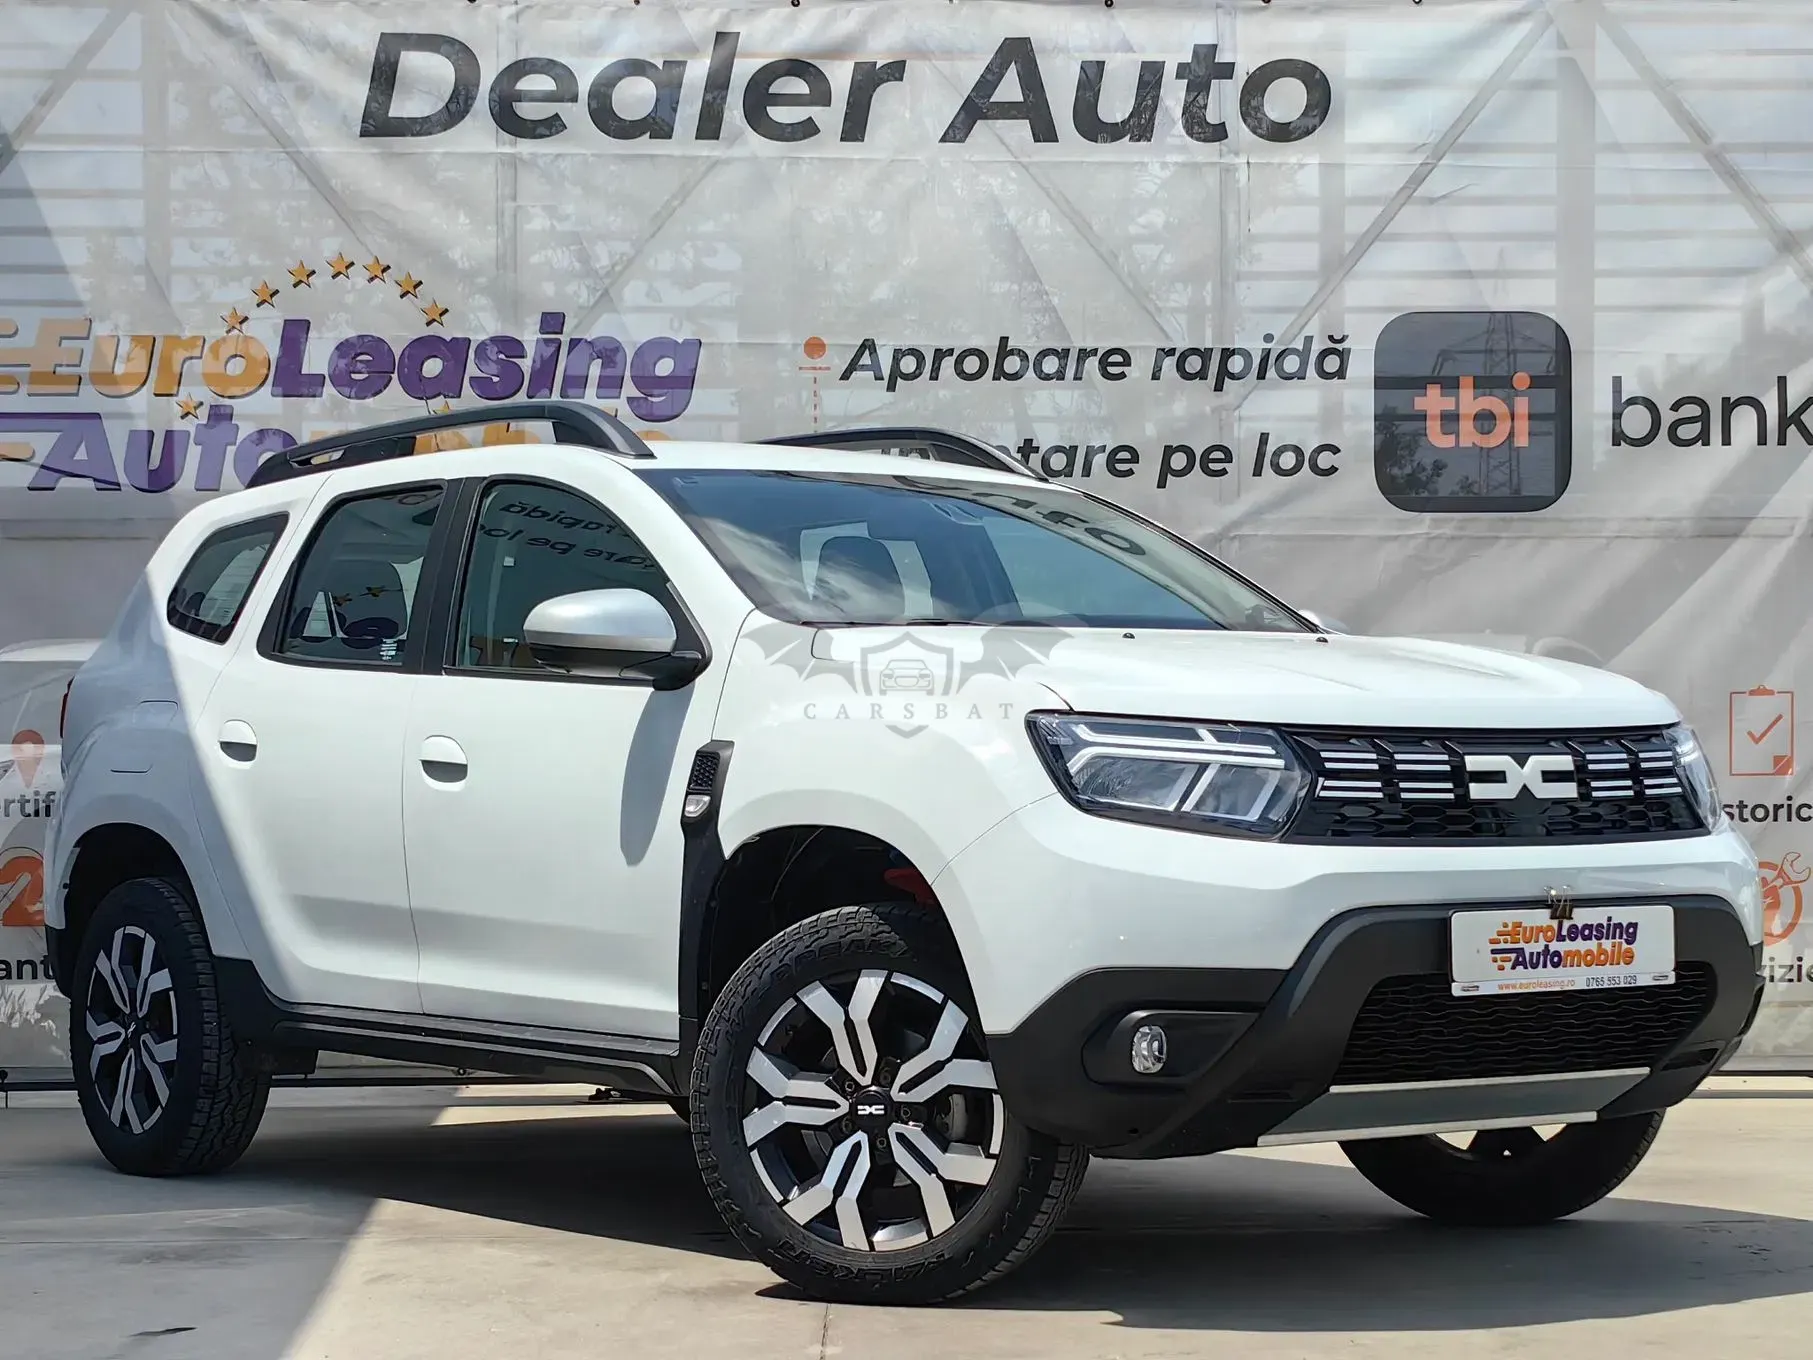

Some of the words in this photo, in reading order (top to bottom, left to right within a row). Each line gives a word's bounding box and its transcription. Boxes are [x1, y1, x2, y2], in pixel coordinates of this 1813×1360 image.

[359, 31, 906, 143] Dealer
[939, 37, 1332, 144] Auto
[27, 312, 701, 421] EuroLeasing
[839, 336, 1132, 392] Aprobare
[1150, 332, 1353, 393] rapidă
[1413, 371, 1532, 448] tbi
[1611, 375, 1813, 447] bank
[1156, 441, 1233, 488] pe
[1252, 433, 1341, 478] loc
[0, 791, 57, 818] rtif
[1509, 916, 1639, 945] EuroLeasing
[1511, 941, 1636, 971] Automobile
[1498, 979, 1576, 990] www.euroleasing.ro
[1585, 976, 1605, 987] 0765
[1607, 976, 1621, 986] 553
